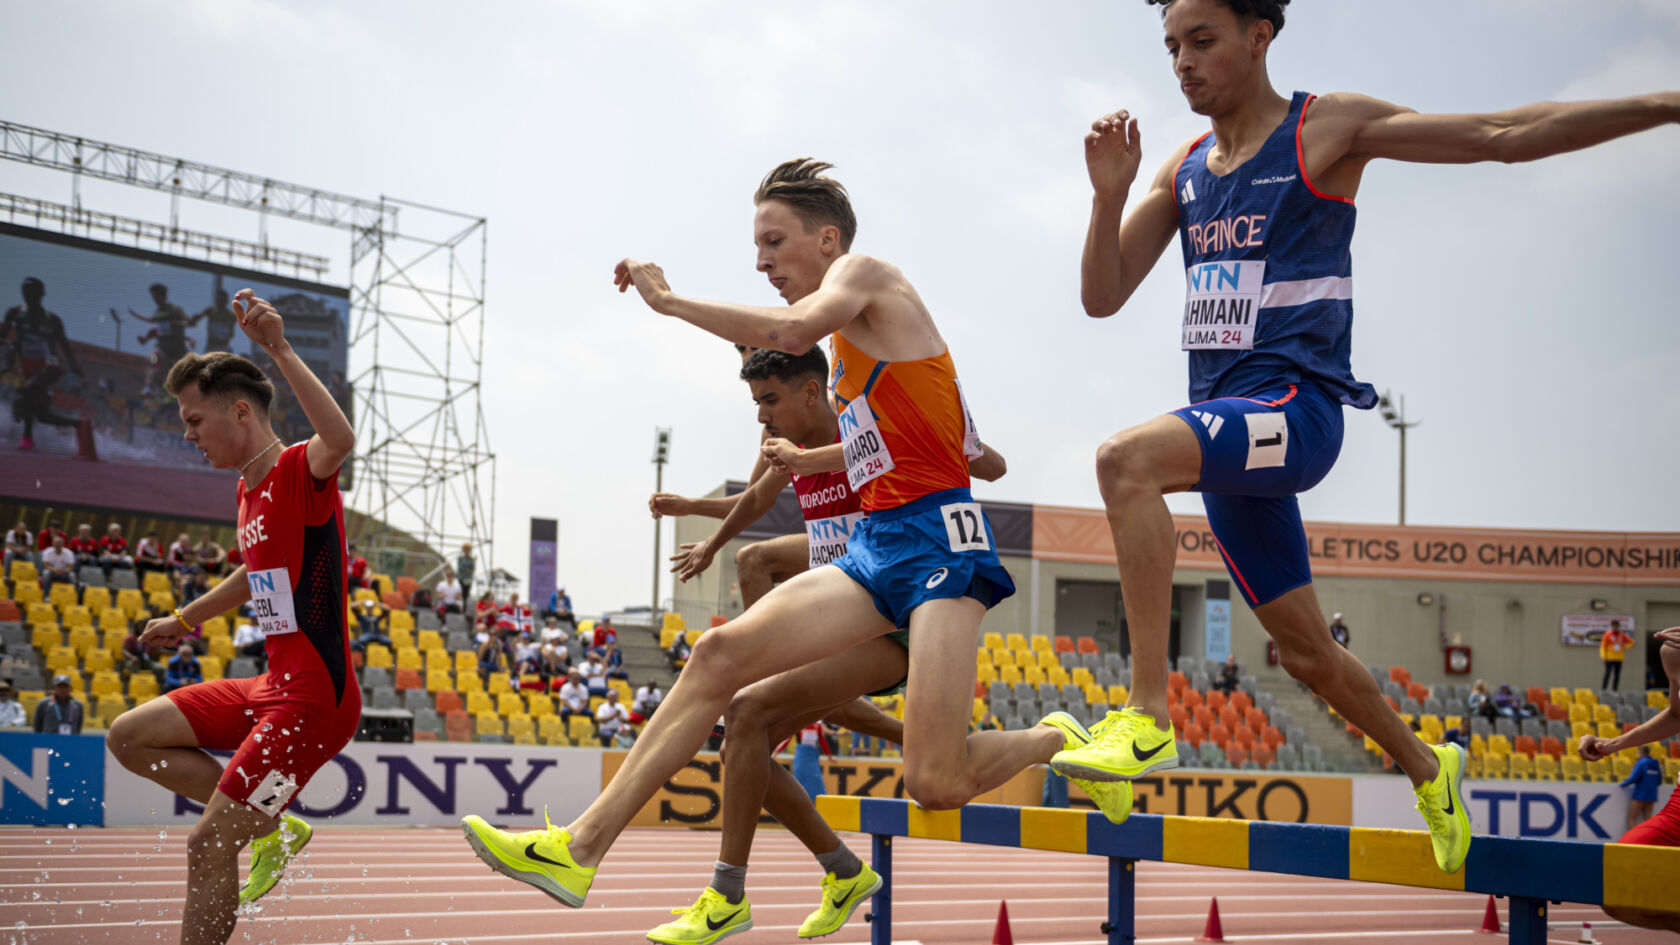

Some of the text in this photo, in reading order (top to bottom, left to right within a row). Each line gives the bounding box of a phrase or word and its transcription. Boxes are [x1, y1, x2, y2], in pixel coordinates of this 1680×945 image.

[1190, 262, 1241, 293] NTN
[1185, 298, 1252, 326] AHMANI
[1188, 330, 1242, 345] LIMA 24
[1255, 431, 1282, 448] 1
[866, 458, 883, 475] 24
[799, 483, 847, 509] MOROCCO
[811, 516, 850, 540] NTN
[950, 509, 985, 545] 12
[1308, 535, 1400, 562] LETICS
[1413, 541, 1468, 564] U20
[274, 619, 289, 631] 24
[1470, 789, 1612, 839] TDK
